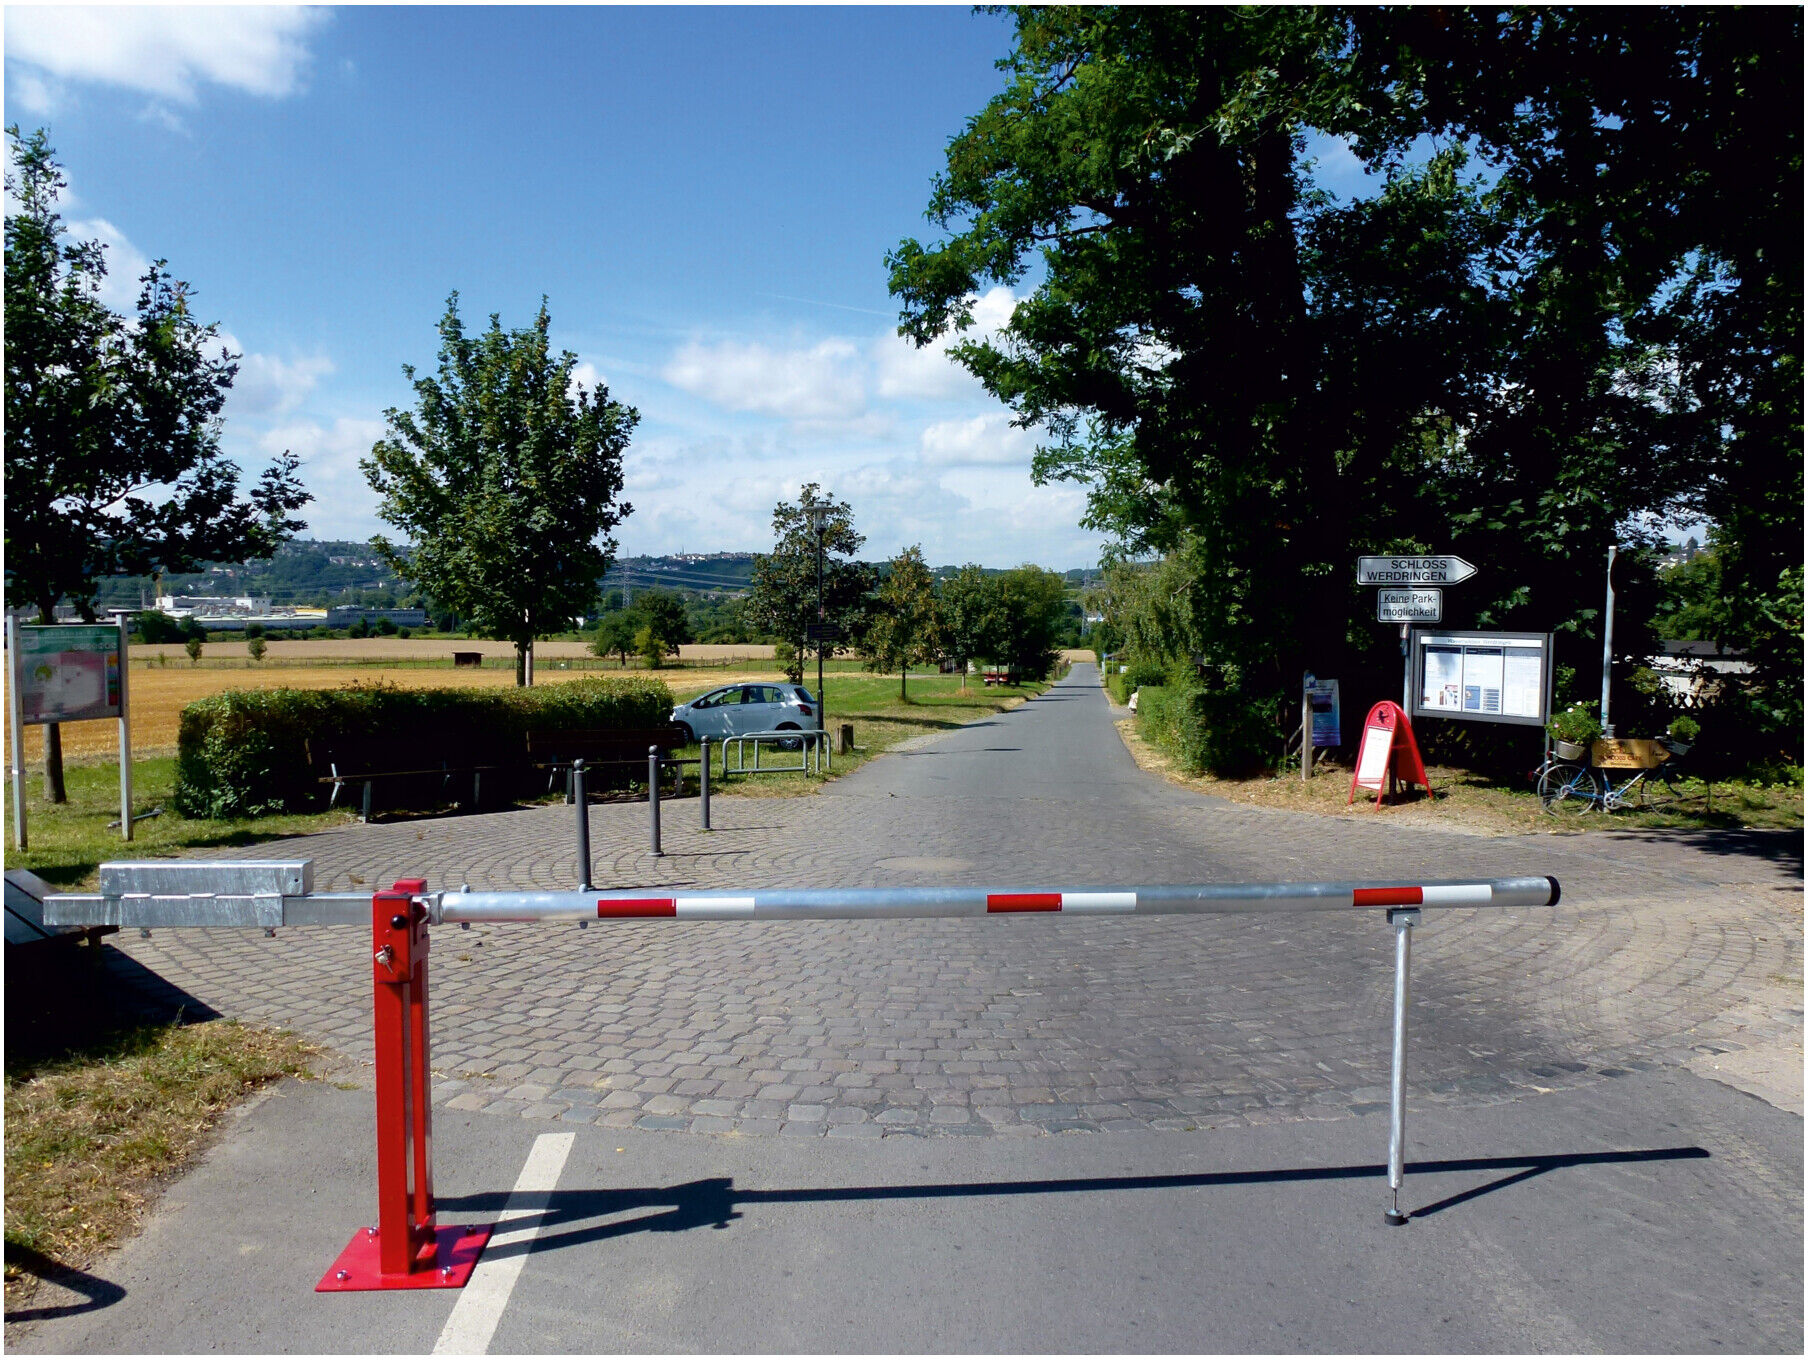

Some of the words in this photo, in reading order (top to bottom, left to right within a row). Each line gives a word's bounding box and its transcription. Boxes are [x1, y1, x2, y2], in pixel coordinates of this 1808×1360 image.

[1391, 560, 1447, 569] SCHLOSS
[1367, 571, 1447, 581] WERDRINGEN
[1384, 593, 1409, 604] Keine
[1412, 593, 1436, 604] Park-
[1383, 605, 1436, 618] möglichkeit
